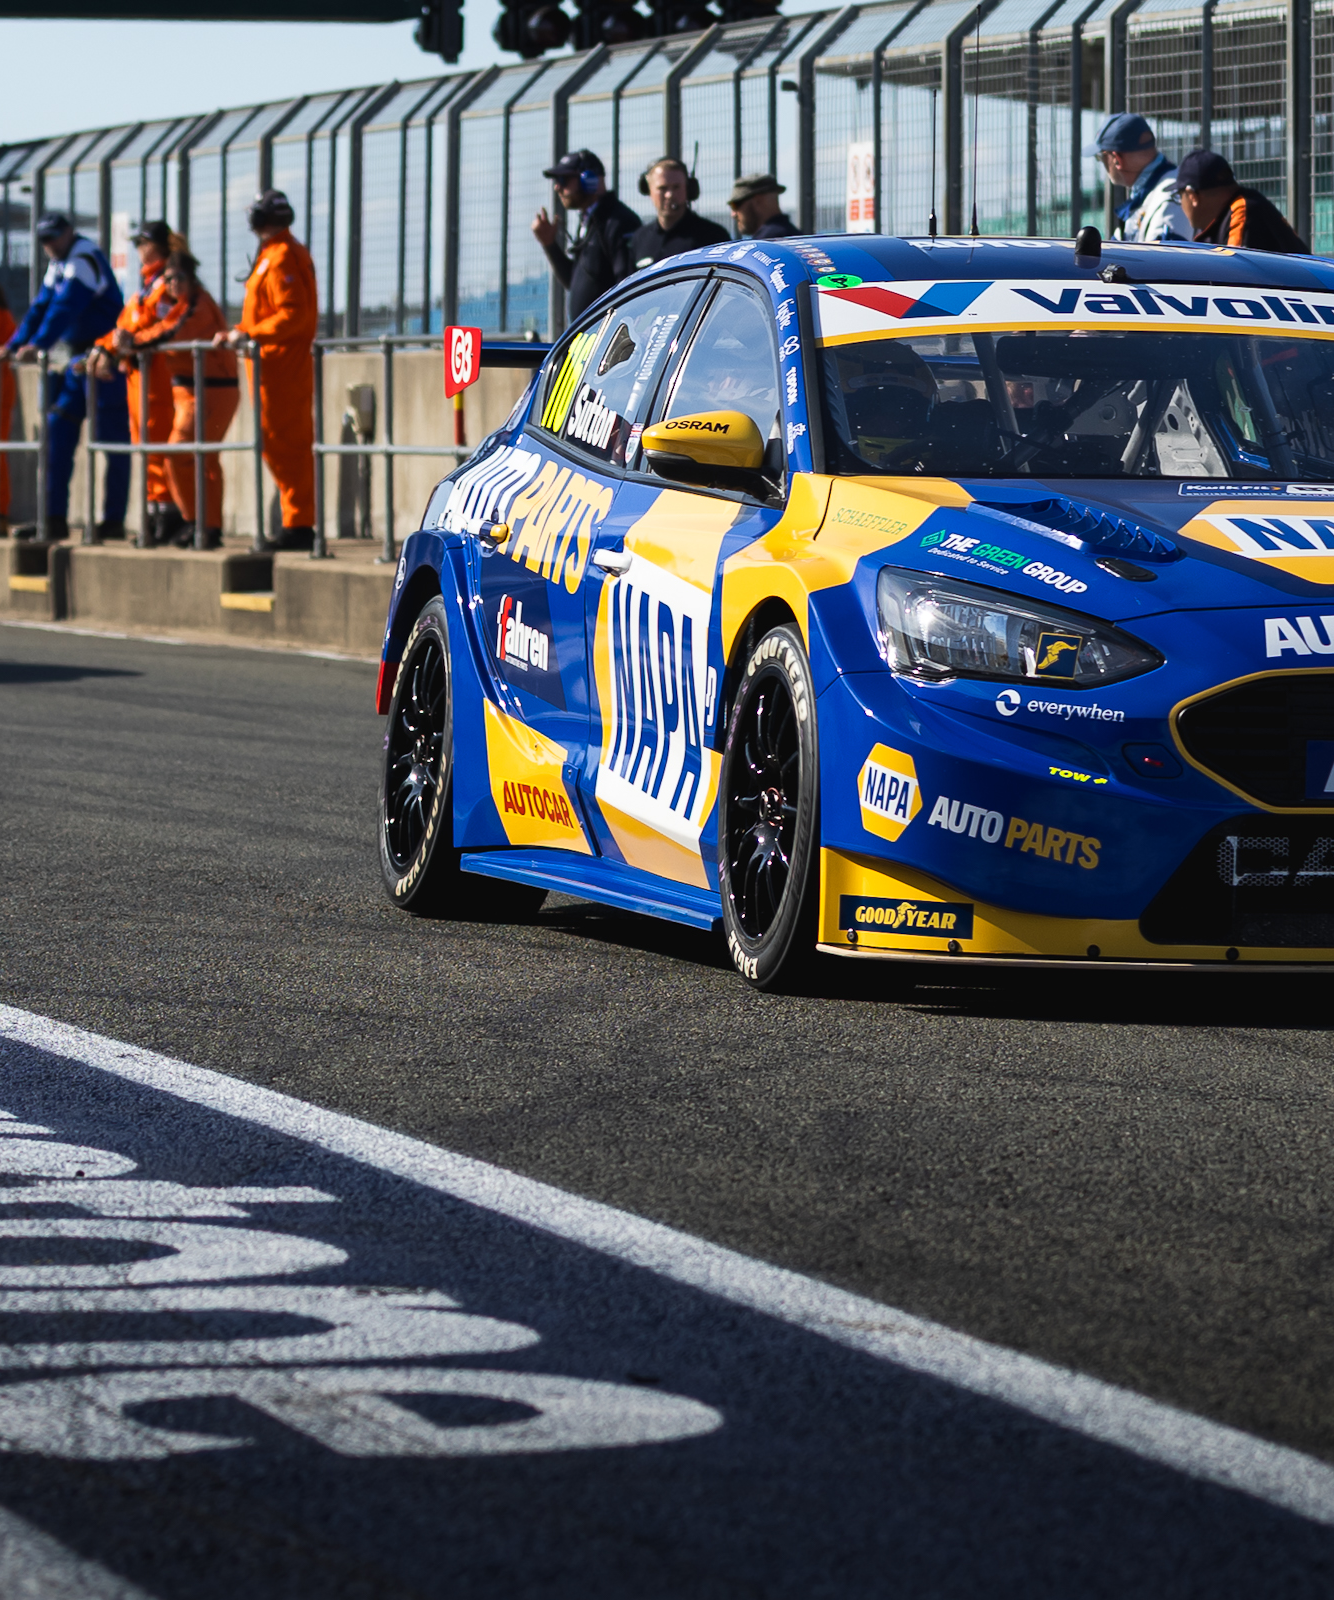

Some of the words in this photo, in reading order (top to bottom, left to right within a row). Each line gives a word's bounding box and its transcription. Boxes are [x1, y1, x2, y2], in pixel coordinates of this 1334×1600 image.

[541, 332, 597, 433] 116
[568, 384, 617, 449] Sutton
[665, 420, 730, 434] OSRAM
[437, 445, 542, 534] AUTO
[497, 460, 614, 594] PARTS
[831, 507, 908, 536] SCHAEFFLER
[927, 547, 968, 563] Dedicated
[968, 556, 977, 565] to
[976, 560, 1009, 575] Service
[940, 533, 980, 553] THE
[972, 543, 1031, 570] GREEN
[1023, 561, 1088, 594] GROUP
[496, 594, 548, 671] fahren
[609, 579, 702, 821] NAPA
[747, 636, 807, 722] GOODYEAR
[1028, 699, 1125, 722] everywhen
[865, 766, 910, 819] NAPA
[1049, 767, 1091, 783] TOW
[504, 781, 574, 829] AUTOCAR
[927, 795, 1004, 843] AUTO
[1004, 817, 1102, 869] PARTS
[855, 902, 957, 930] GOODYEAR
[728, 929, 759, 979] EAGLE
